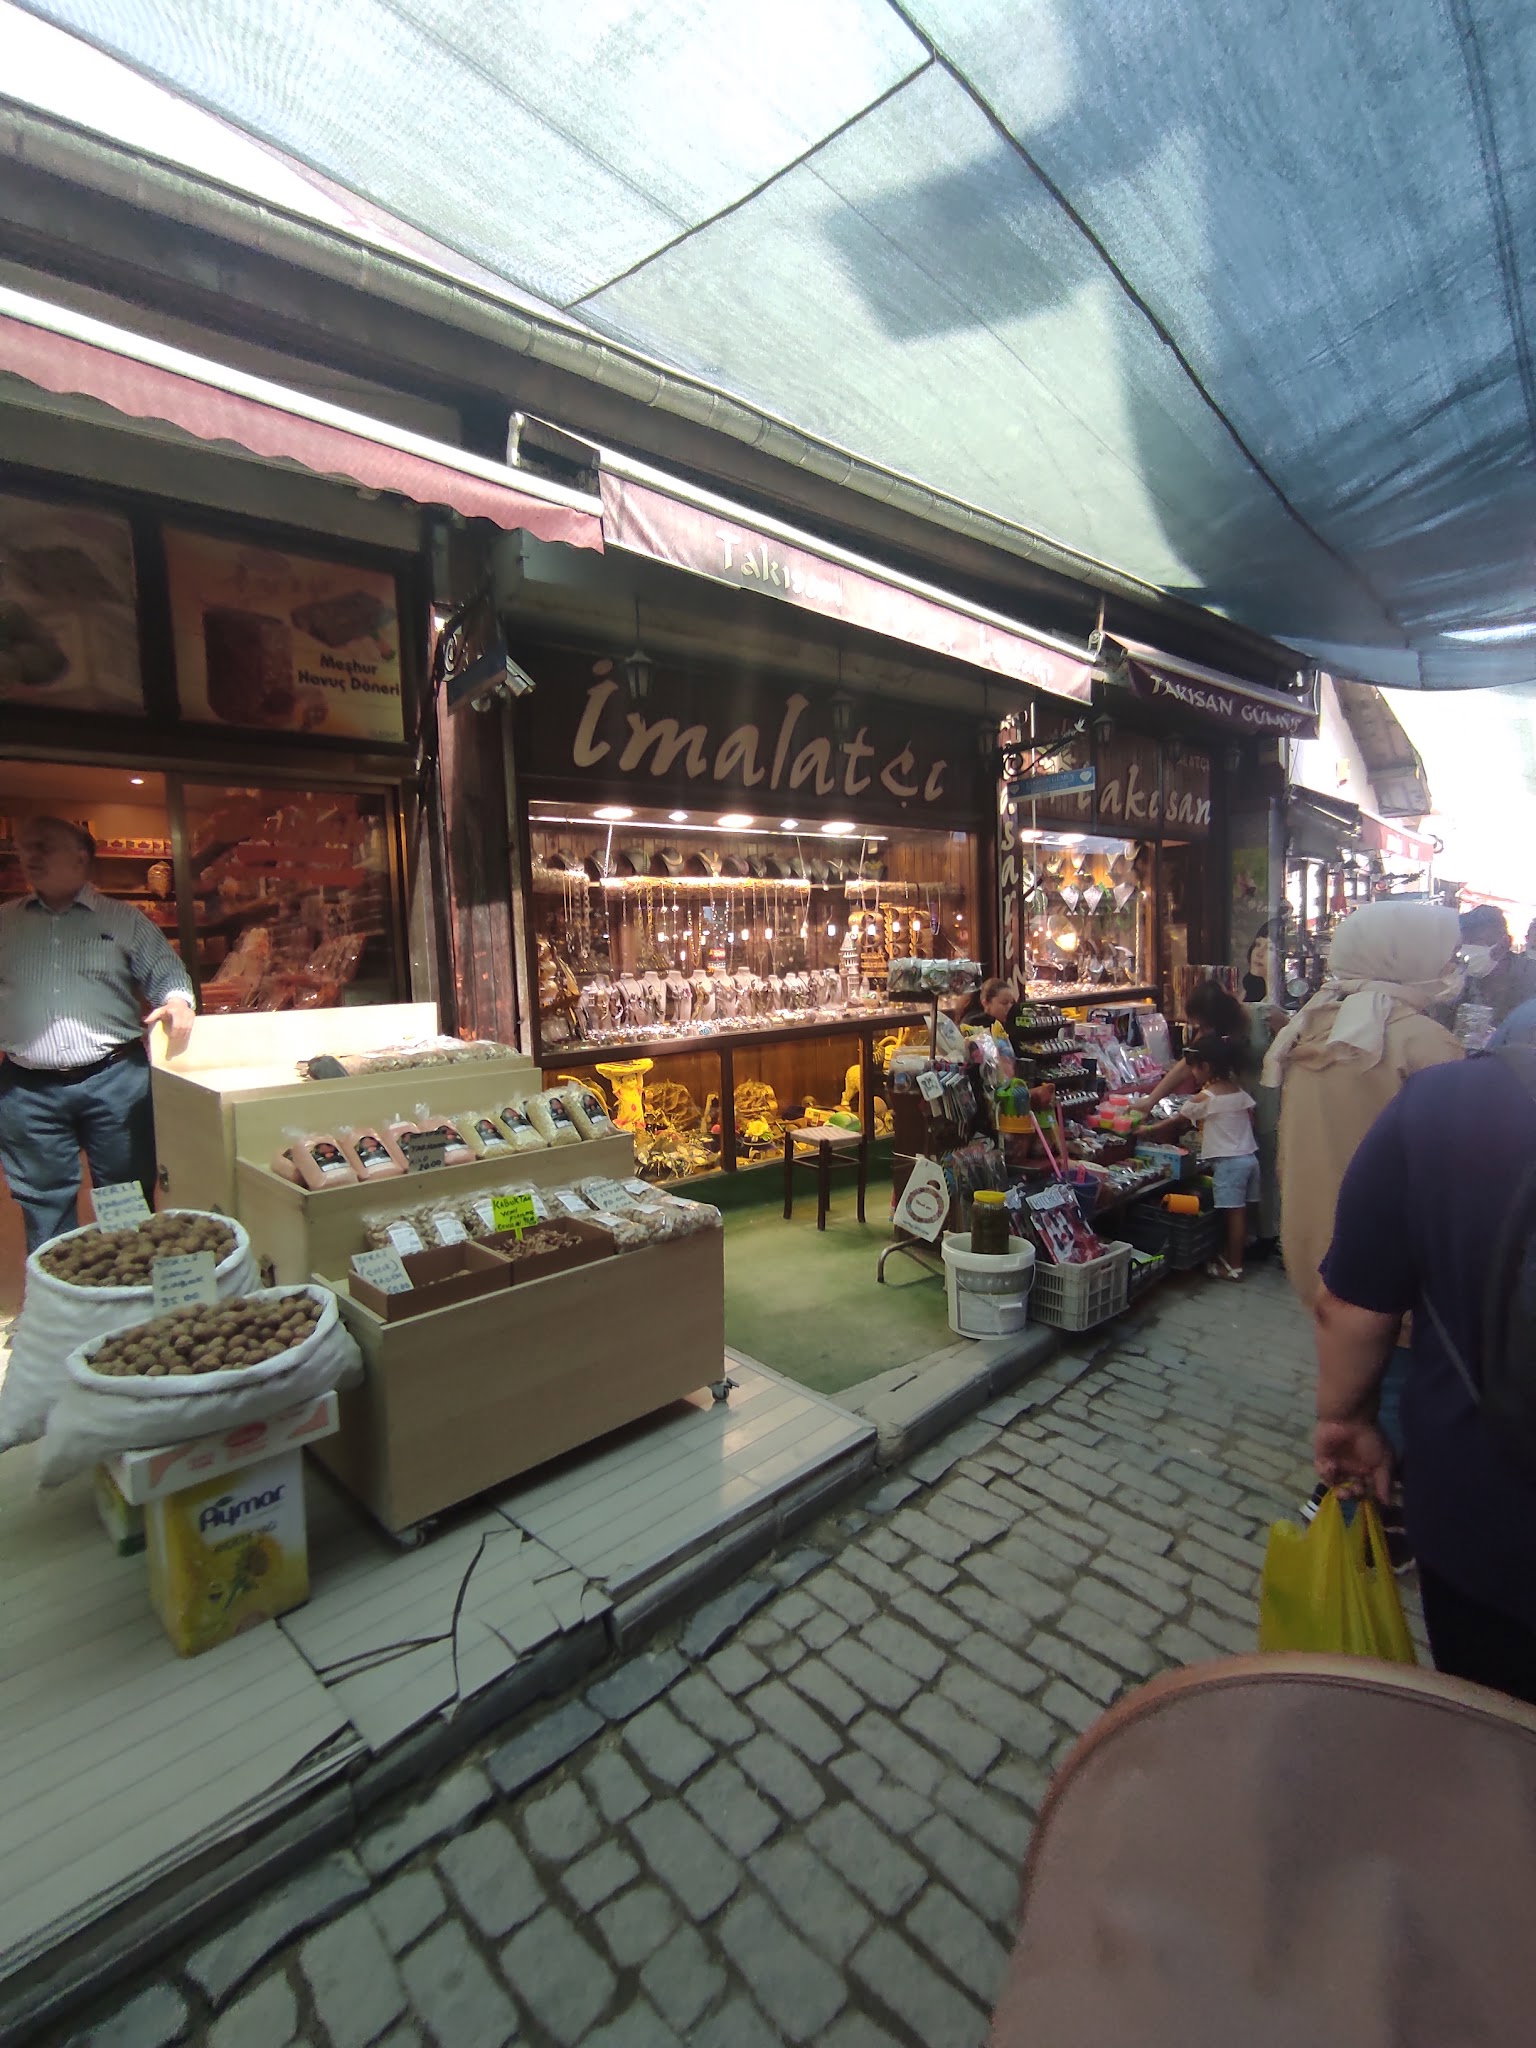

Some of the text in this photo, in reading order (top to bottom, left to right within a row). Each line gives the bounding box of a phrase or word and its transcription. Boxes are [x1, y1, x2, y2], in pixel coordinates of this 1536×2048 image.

[319, 655, 379, 675] Meşhur
[350, 677, 400, 697] Döneri
[1149, 673, 1234, 716] TAKISAN
